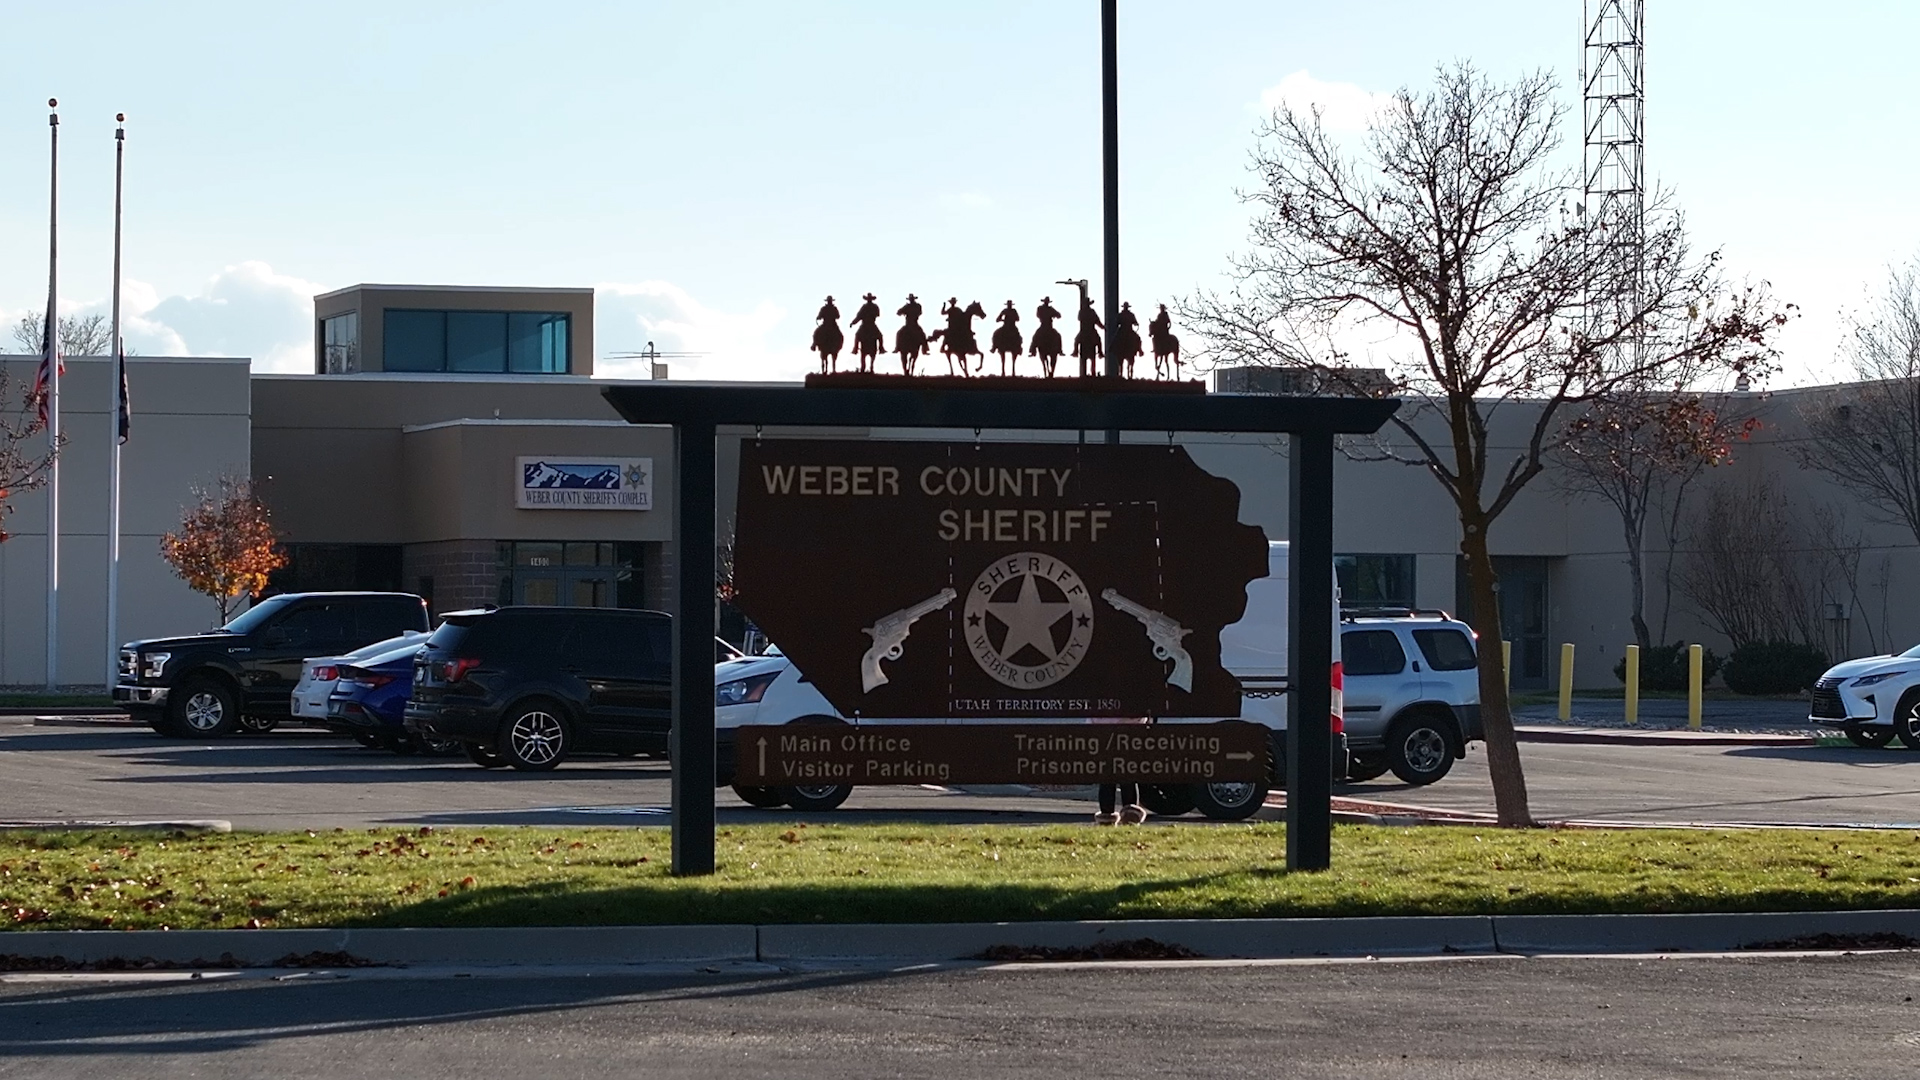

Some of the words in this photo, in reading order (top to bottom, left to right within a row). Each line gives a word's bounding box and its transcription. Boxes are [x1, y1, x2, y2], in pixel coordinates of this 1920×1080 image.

[762, 465, 899, 495] WEBER
[920, 465, 1072, 497] COUNTY
[525, 490, 551, 504] WEBER
[552, 491, 581, 505] COUNTY
[617, 492, 648, 505] COMPLEX
[937, 509, 1112, 542] SHERIFF
[977, 557, 1083, 595] SHERIFF
[974, 635, 1018, 682] WEBER
[1023, 637, 1083, 684] COUNTY
[955, 699, 991, 710] UTAH
[996, 699, 1065, 710] TERRITORY
[1068, 699, 1092, 711] EST.
[1097, 699, 1121, 710] 1850
[780, 735, 831, 752] Main
[841, 735, 911, 752] Office
[782, 760, 854, 777] Visitor
[866, 760, 950, 780] Parking
[1017, 757, 1106, 775] Prisoner
[1112, 757, 1215, 778] Receiving
